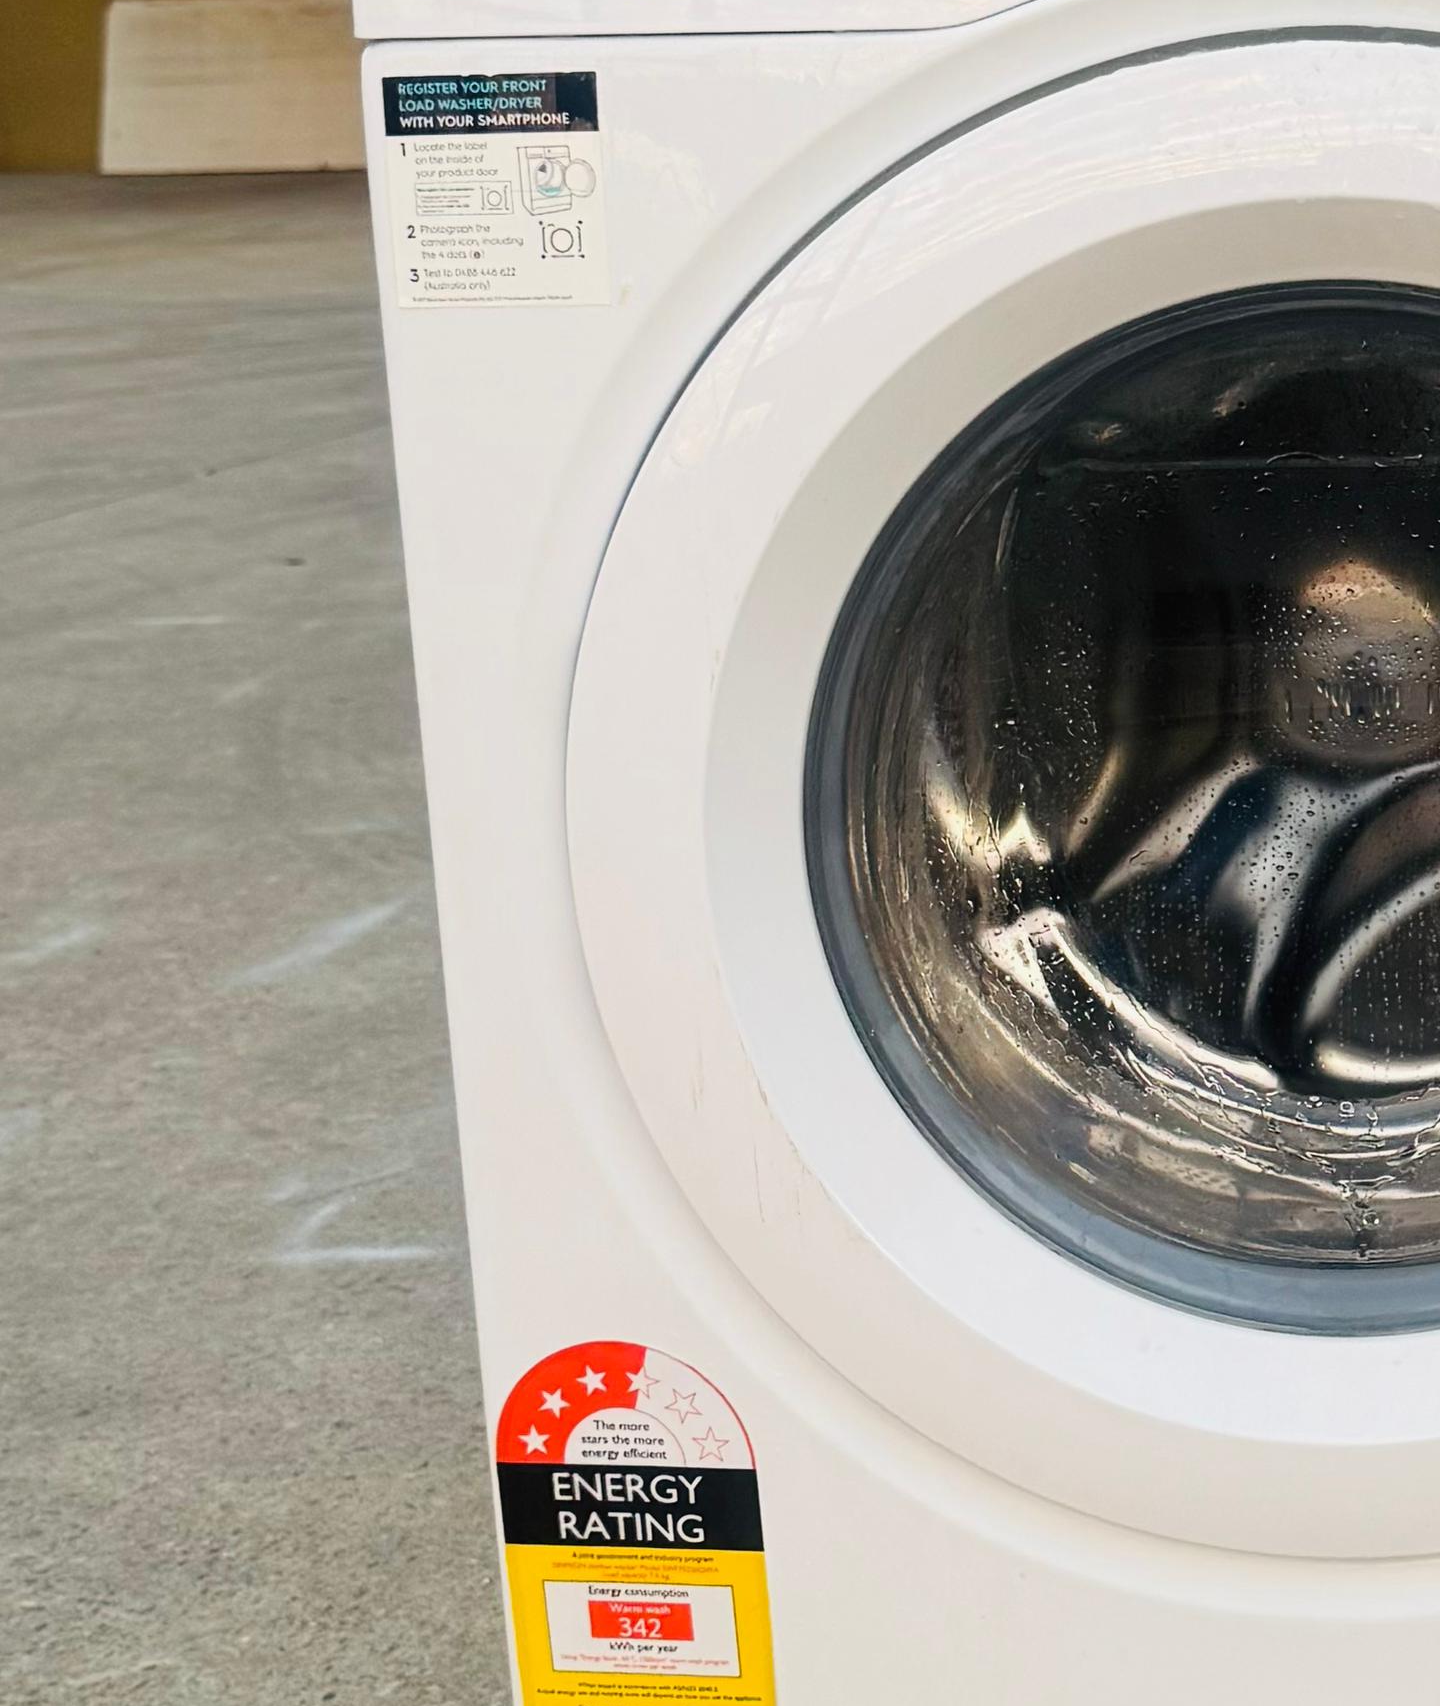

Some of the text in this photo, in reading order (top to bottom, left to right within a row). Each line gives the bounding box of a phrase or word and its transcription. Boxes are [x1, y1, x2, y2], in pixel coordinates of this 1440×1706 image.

[398, 80, 547, 95] REGISTER YOUR FRONT
[399, 97, 542, 112] LOAD WASHER/DRYER
[400, 112, 570, 128] WITH YOUR SMARTPHONE
[400, 143, 406, 156] 1
[407, 225, 416, 238] 2
[410, 269, 419, 282] 3
[593, 1419, 650, 1431] The more
[582, 1435, 664, 1446] stars the more
[582, 1449, 667, 1460] energy efficient
[552, 1472, 703, 1504] ENERGY
[558, 1511, 705, 1543] RATING
[588, 1585, 689, 1599] Energy consumption
[646, 1605, 671, 1614] wash
[619, 1617, 663, 1638] 342
[638, 1644, 654, 1653] per
[658, 1645, 678, 1653] year
